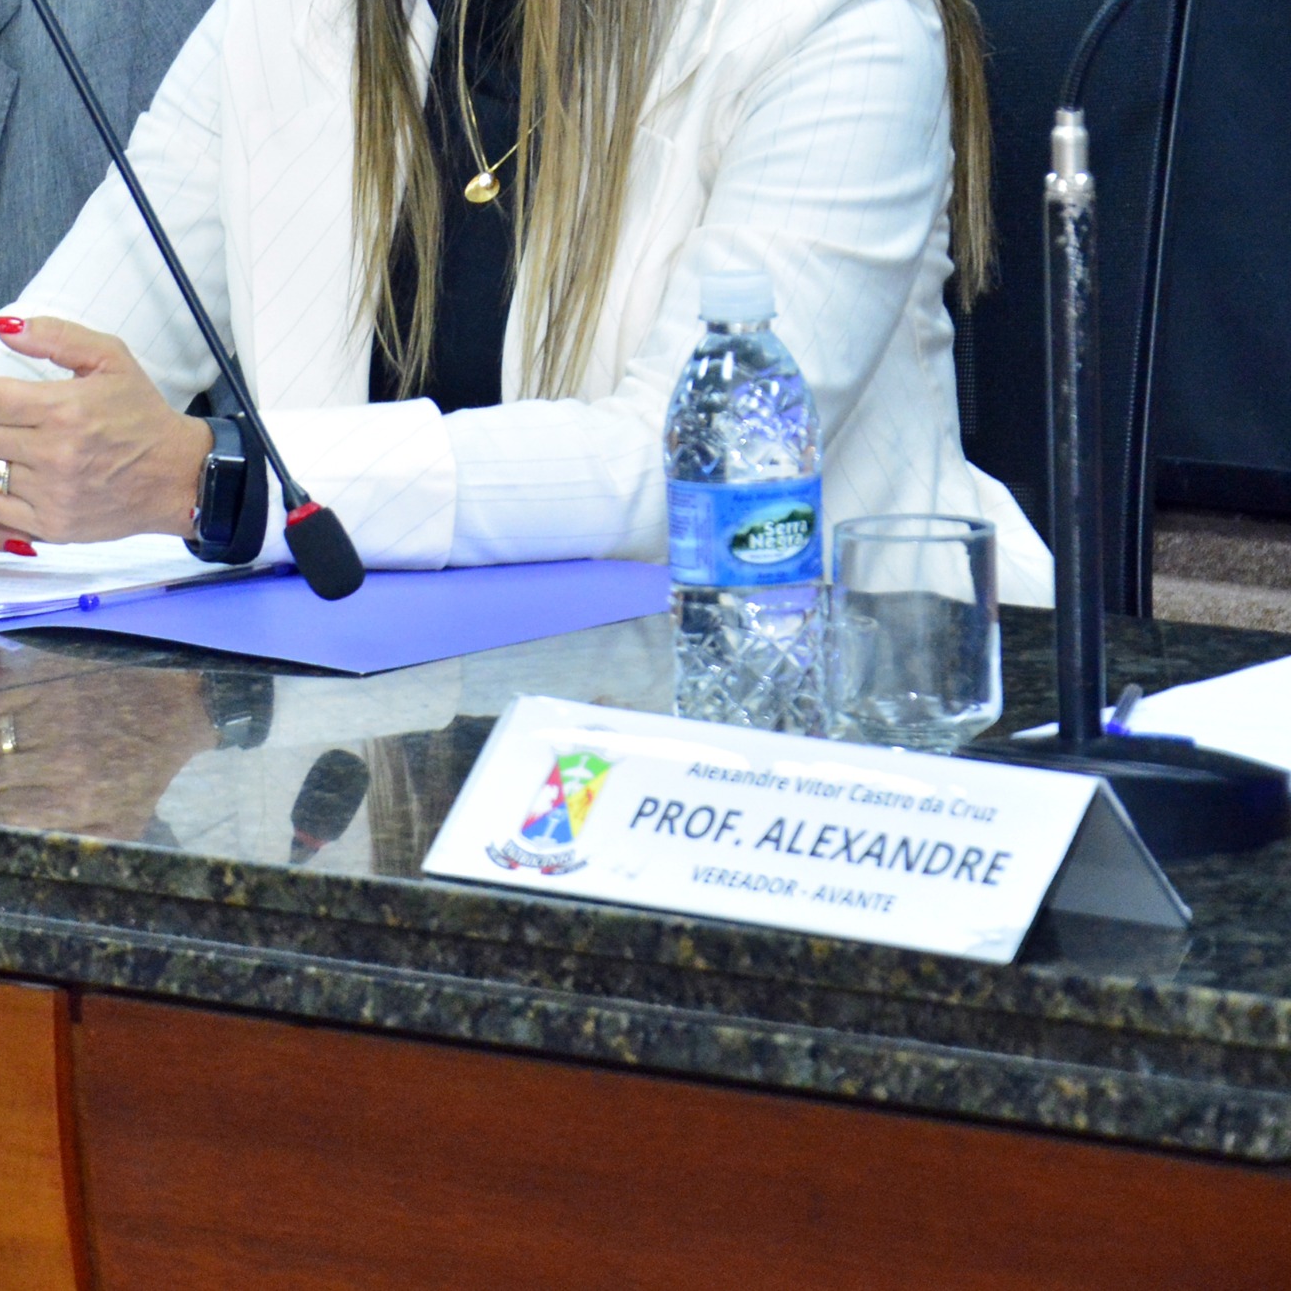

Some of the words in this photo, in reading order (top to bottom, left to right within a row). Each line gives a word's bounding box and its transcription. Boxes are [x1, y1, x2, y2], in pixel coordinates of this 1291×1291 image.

[748, 533, 804, 551] Negra
[763, 520, 808, 536] Serra
[686, 761, 790, 791] Alexandre
[794, 775, 844, 799] Vitor
[849, 783, 915, 810] Castro
[918, 795, 945, 814] da
[949, 798, 997, 823] Cruz
[630, 796, 744, 847] PROF.
[755, 817, 1013, 887] ALEXANDRE
[691, 865, 799, 898] VEREADOR
[810, 883, 897, 913] AVANTE
